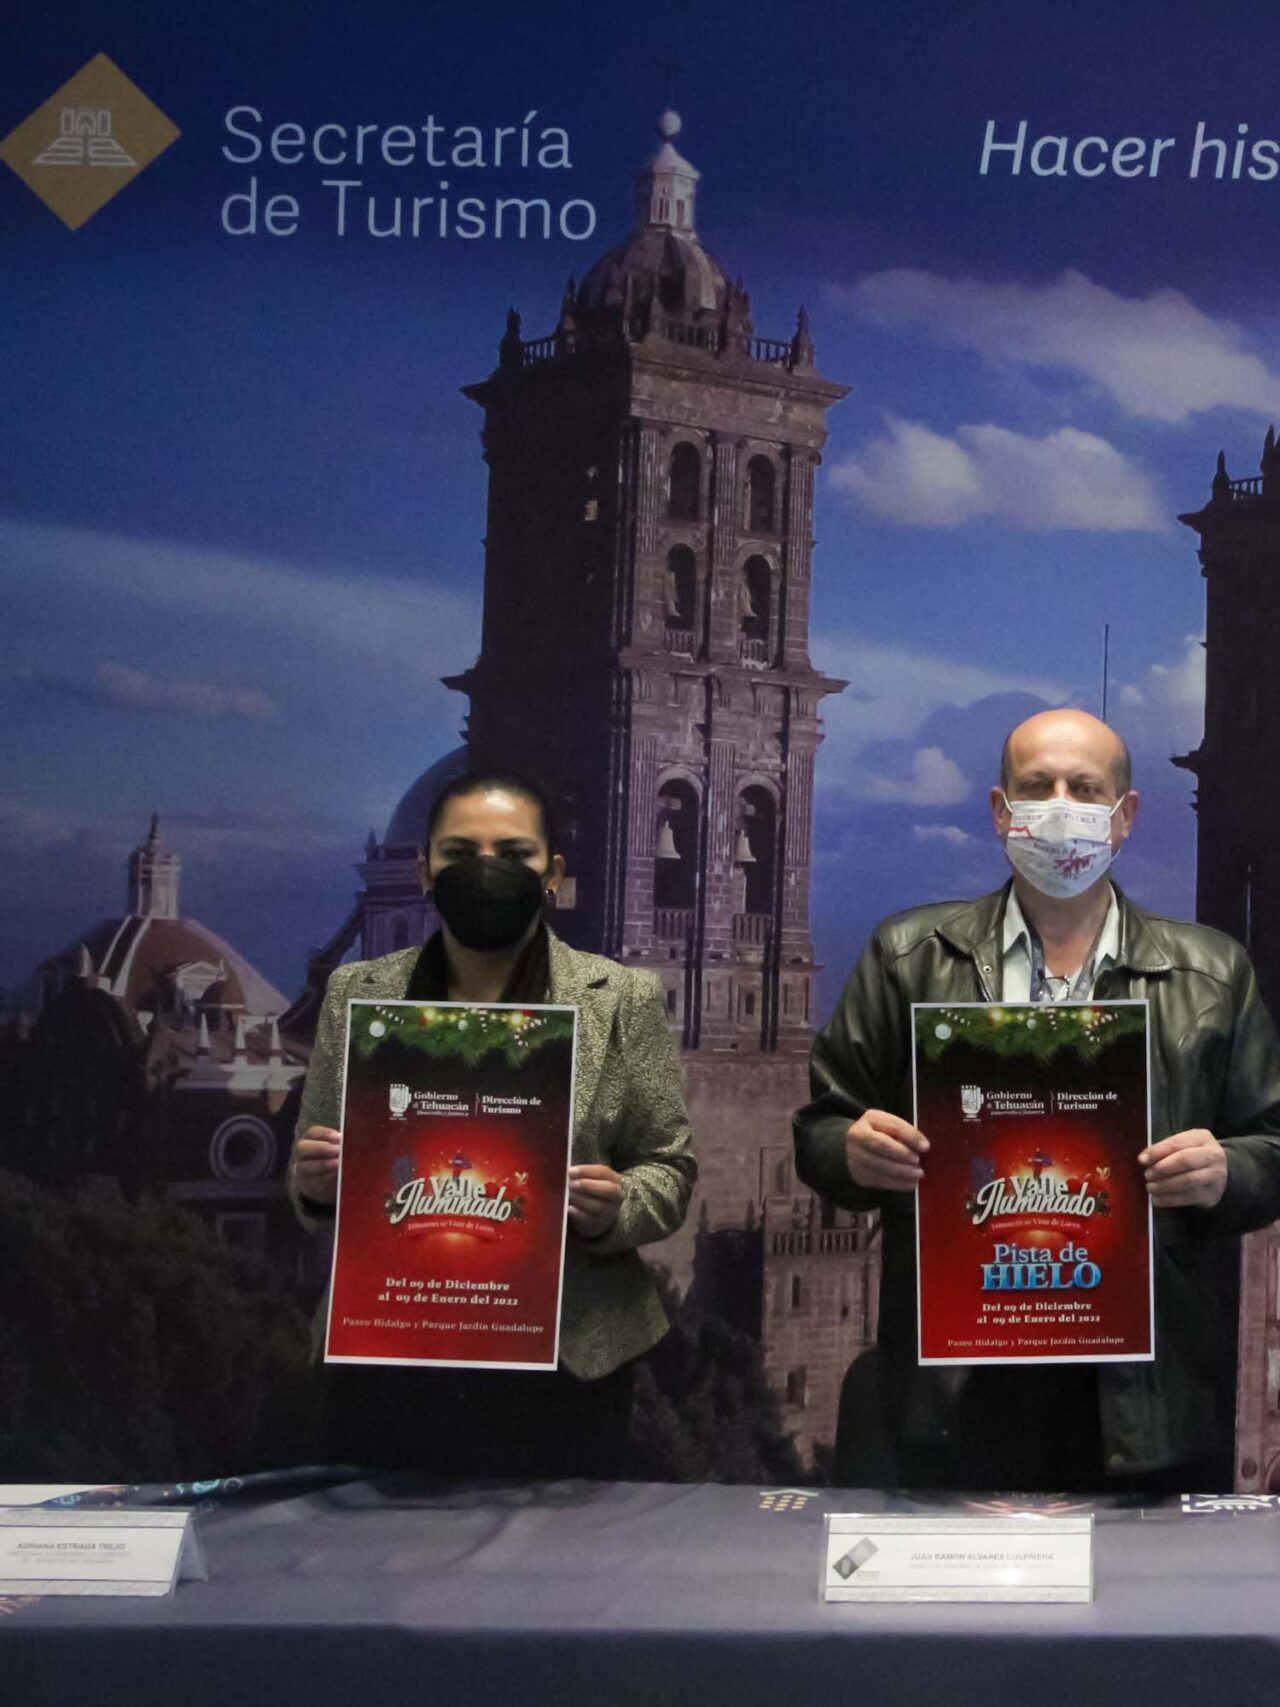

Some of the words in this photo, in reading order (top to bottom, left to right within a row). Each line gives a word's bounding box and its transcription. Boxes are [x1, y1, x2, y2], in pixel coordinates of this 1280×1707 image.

[221, 106, 573, 169] Secretaría
[980, 121, 1175, 176] Hacer
[221, 176, 299, 236] de
[322, 180, 597, 240] Turismo
[414, 1091, 459, 1101] Gobierno
[529, 1096, 541, 1106] de
[986, 1091, 1032, 1100] Gobierno
[1106, 1091, 1118, 1100] de
[481, 1105, 521, 1114] Turismo
[994, 1099, 1044, 1110] Tehuacán
[1057, 1102, 1098, 1111] Turismo
[429, 1176, 486, 1199] Valle
[1010, 1175, 1068, 1198] Valle
[390, 1178, 511, 1224] Iluminado
[972, 1177, 1096, 1225] Iluminado
[993, 1243, 1051, 1264] Pista
[1059, 1241, 1088, 1262] de
[980, 1261, 1102, 1291] HIELO
[386, 1277, 407, 1287] Del
[410, 1280, 424, 1291] 09
[427, 1278, 441, 1288] de
[445, 1280, 510, 1291] Diciembre
[378, 1292, 390, 1302] al
[396, 1294, 410, 1304] 09
[413, 1293, 428, 1303] de
[431, 1294, 467, 1304] Enero
[470, 1294, 490, 1305] del
[493, 1297, 518, 1306] 2022
[982, 1303, 1001, 1312] Del
[1004, 1304, 1016, 1314] 09
[1019, 1302, 1032, 1312] de
[1035, 1302, 1092, 1312] Diciembre
[422, 1320, 456, 1331] Parque
[491, 1322, 544, 1334] Guadalupe
[977, 1316, 987, 1324] al
[993, 1317, 1005, 1326] 09
[1008, 1315, 1021, 1324] de
[1024, 1314, 1056, 1324] Enero
[1058, 1314, 1076, 1323] del
[1018, 1338, 1047, 1348] Parque
